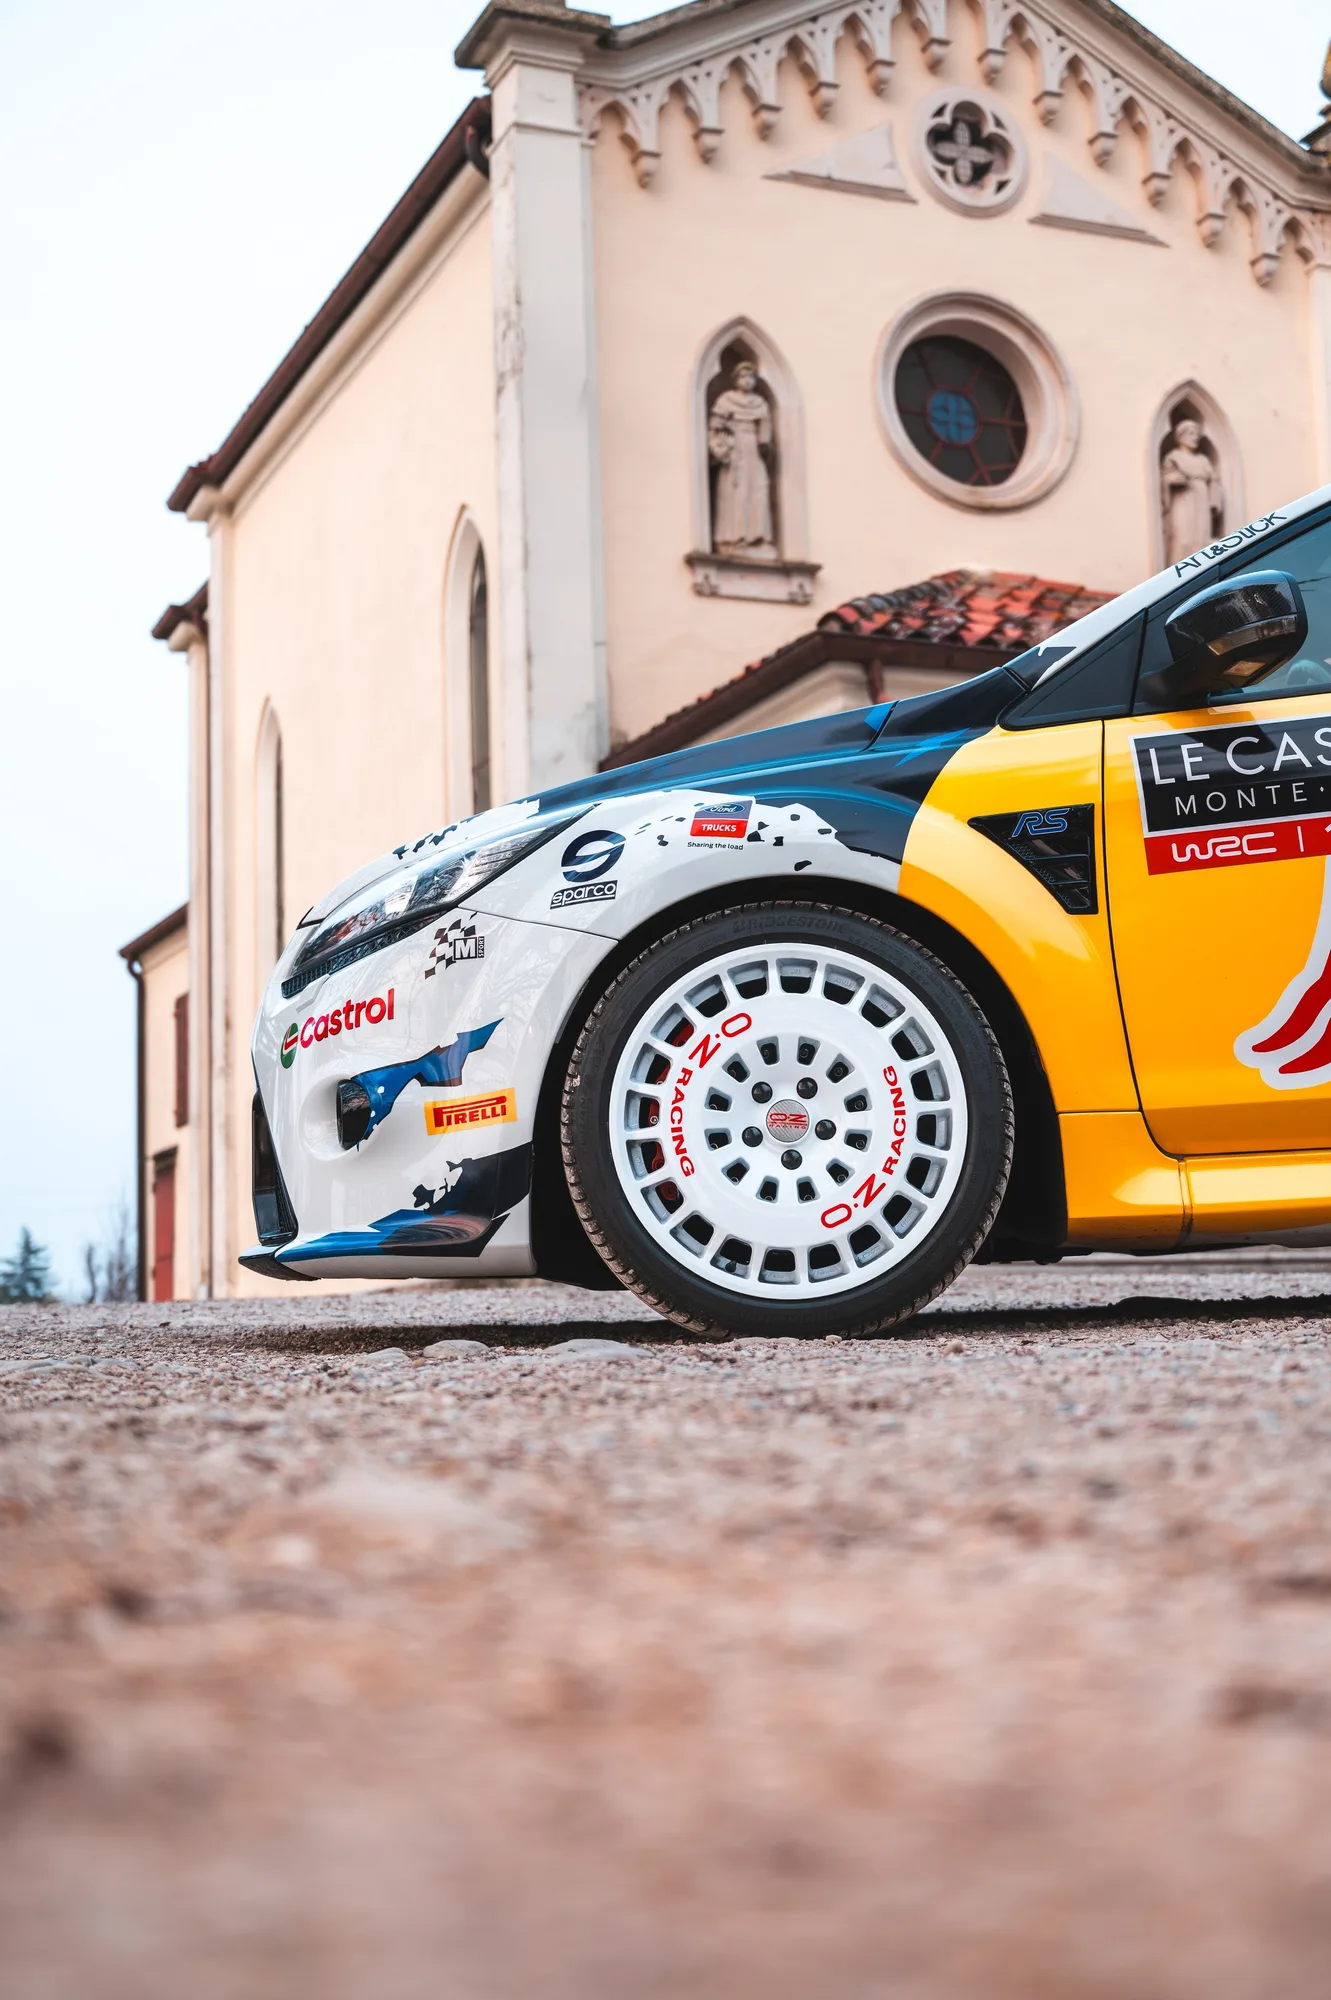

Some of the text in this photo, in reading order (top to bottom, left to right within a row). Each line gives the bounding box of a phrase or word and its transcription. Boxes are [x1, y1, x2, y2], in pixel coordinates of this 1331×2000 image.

[1149, 727, 1331, 785] LE CAS
[710, 804, 736, 813] Ford
[1174, 782, 1308, 816] MONTE
[701, 823, 737, 832] TRUCKS
[1011, 807, 1070, 837] RS
[687, 841, 714, 850] Sharing
[727, 843, 744, 851] load
[1171, 831, 1278, 863] WRC
[552, 882, 617, 907] sparco
[732, 913, 850, 935] BRIDGESTONE
[455, 938, 476, 959] M
[300, 988, 395, 1049] Castrol
[433, 1095, 508, 1128] PIRELLI
[670, 1067, 695, 1178] RACING
[882, 1065, 907, 1176] RACING
